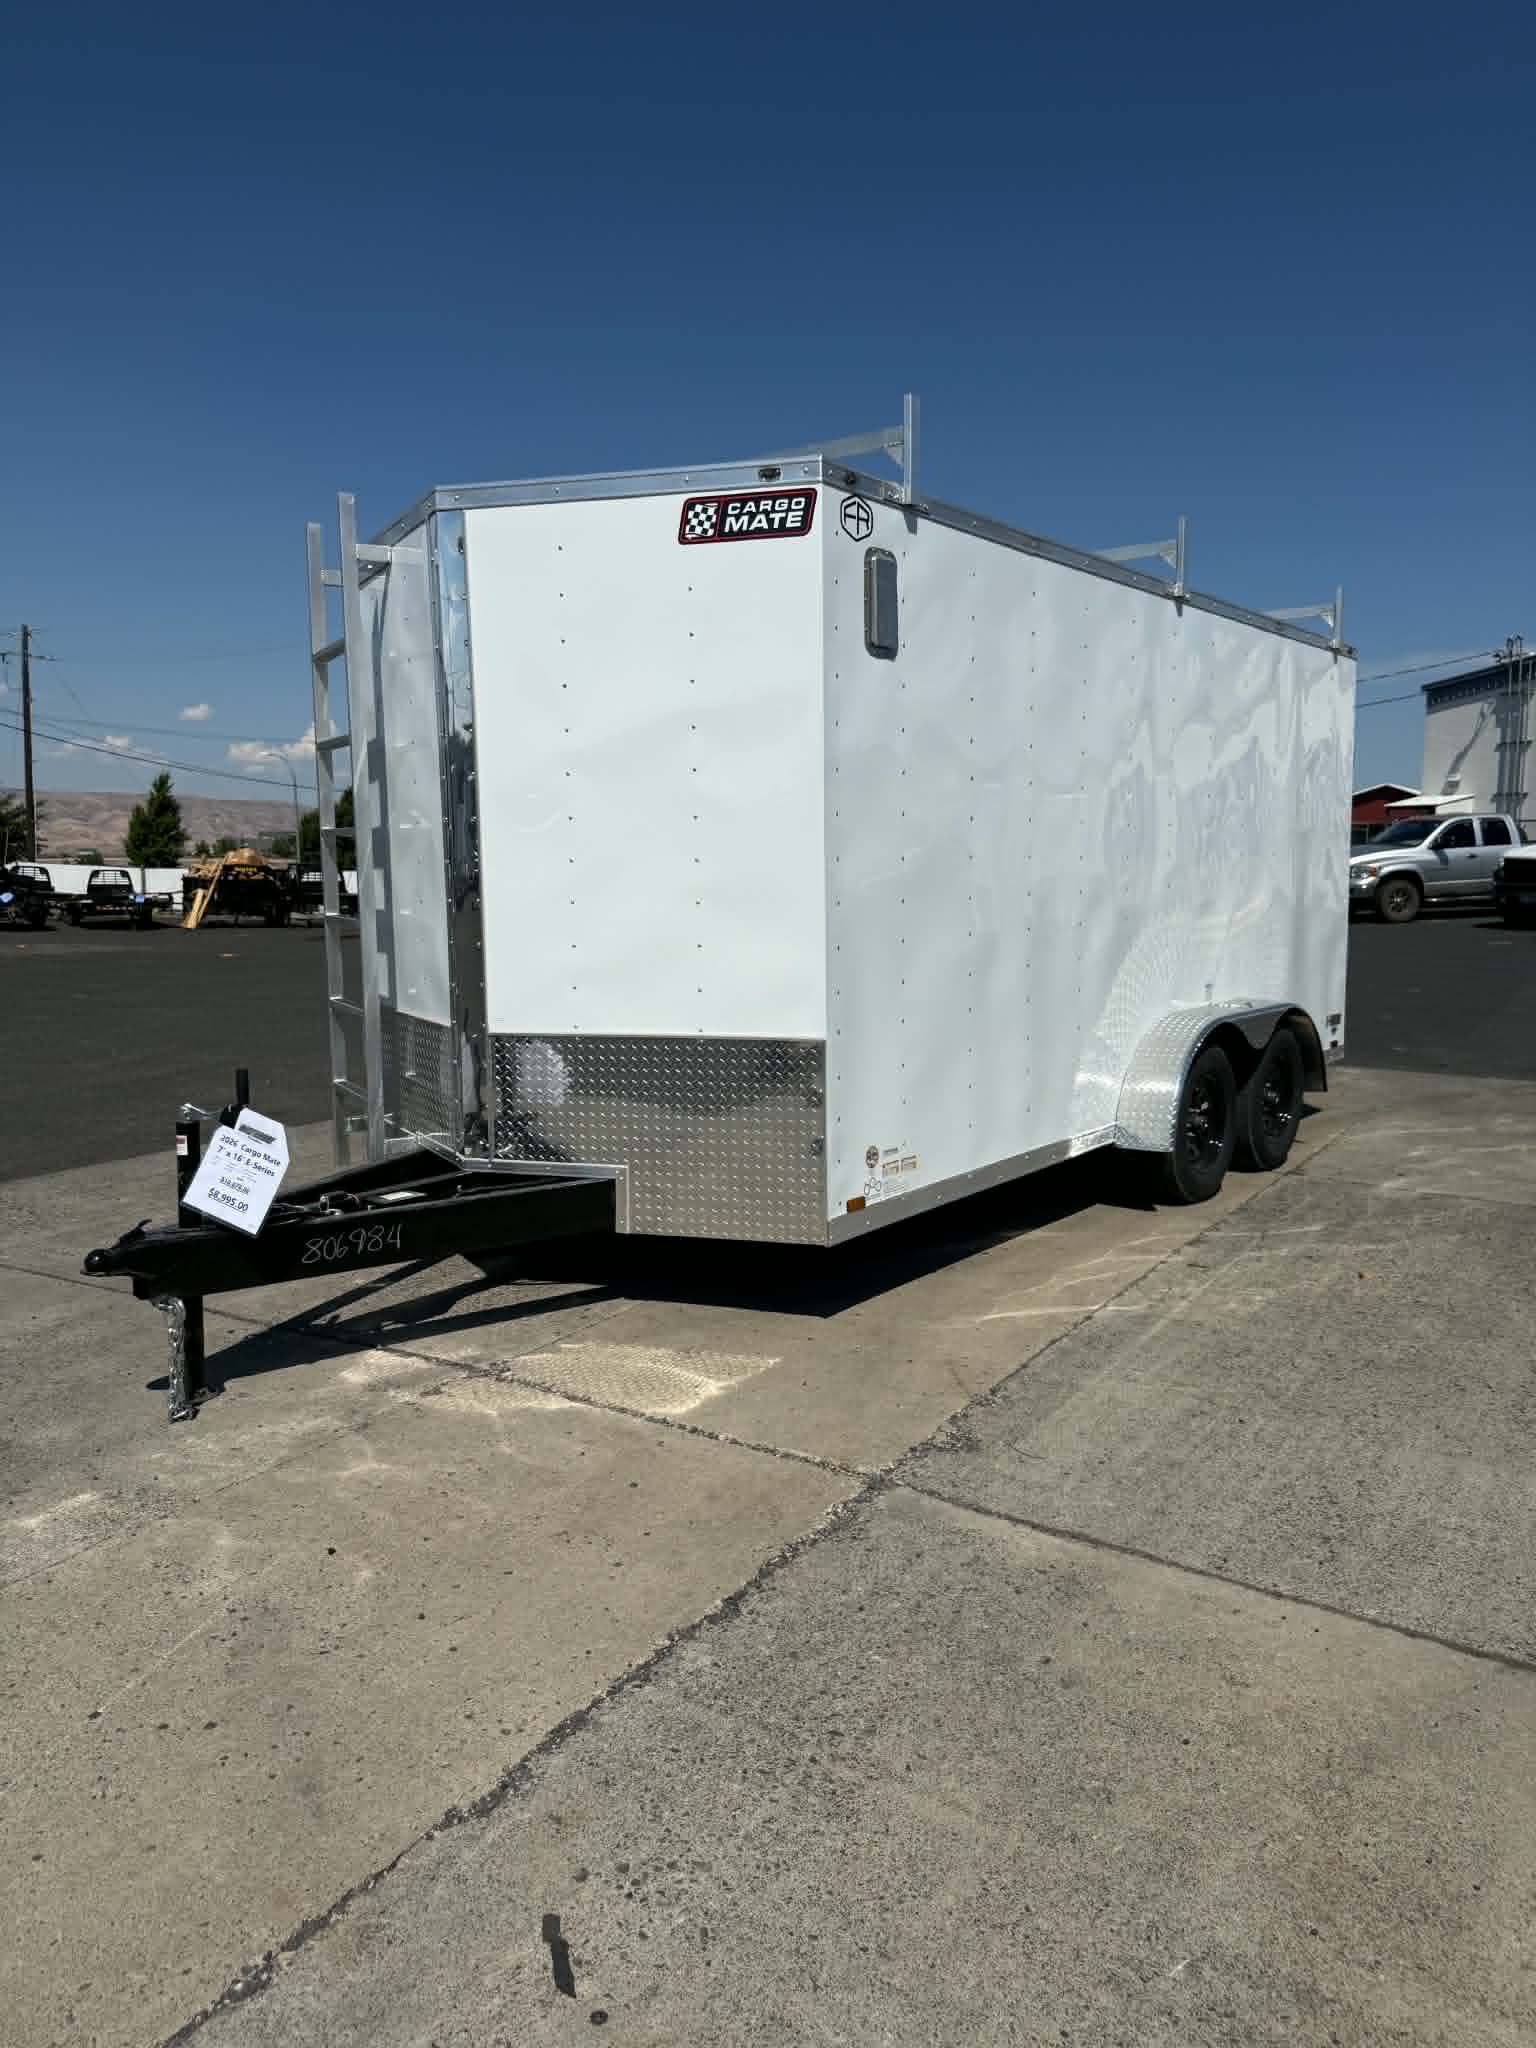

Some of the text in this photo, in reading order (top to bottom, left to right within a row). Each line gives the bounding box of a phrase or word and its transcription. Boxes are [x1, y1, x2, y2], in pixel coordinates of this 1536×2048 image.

[727, 497, 806, 515] CARGO
[724, 511, 804, 533] MATE
[240, 1143, 262, 1158] Cargo
[263, 1153, 281, 1167] Mate
[208, 1187, 249, 1212] $8,995.00
